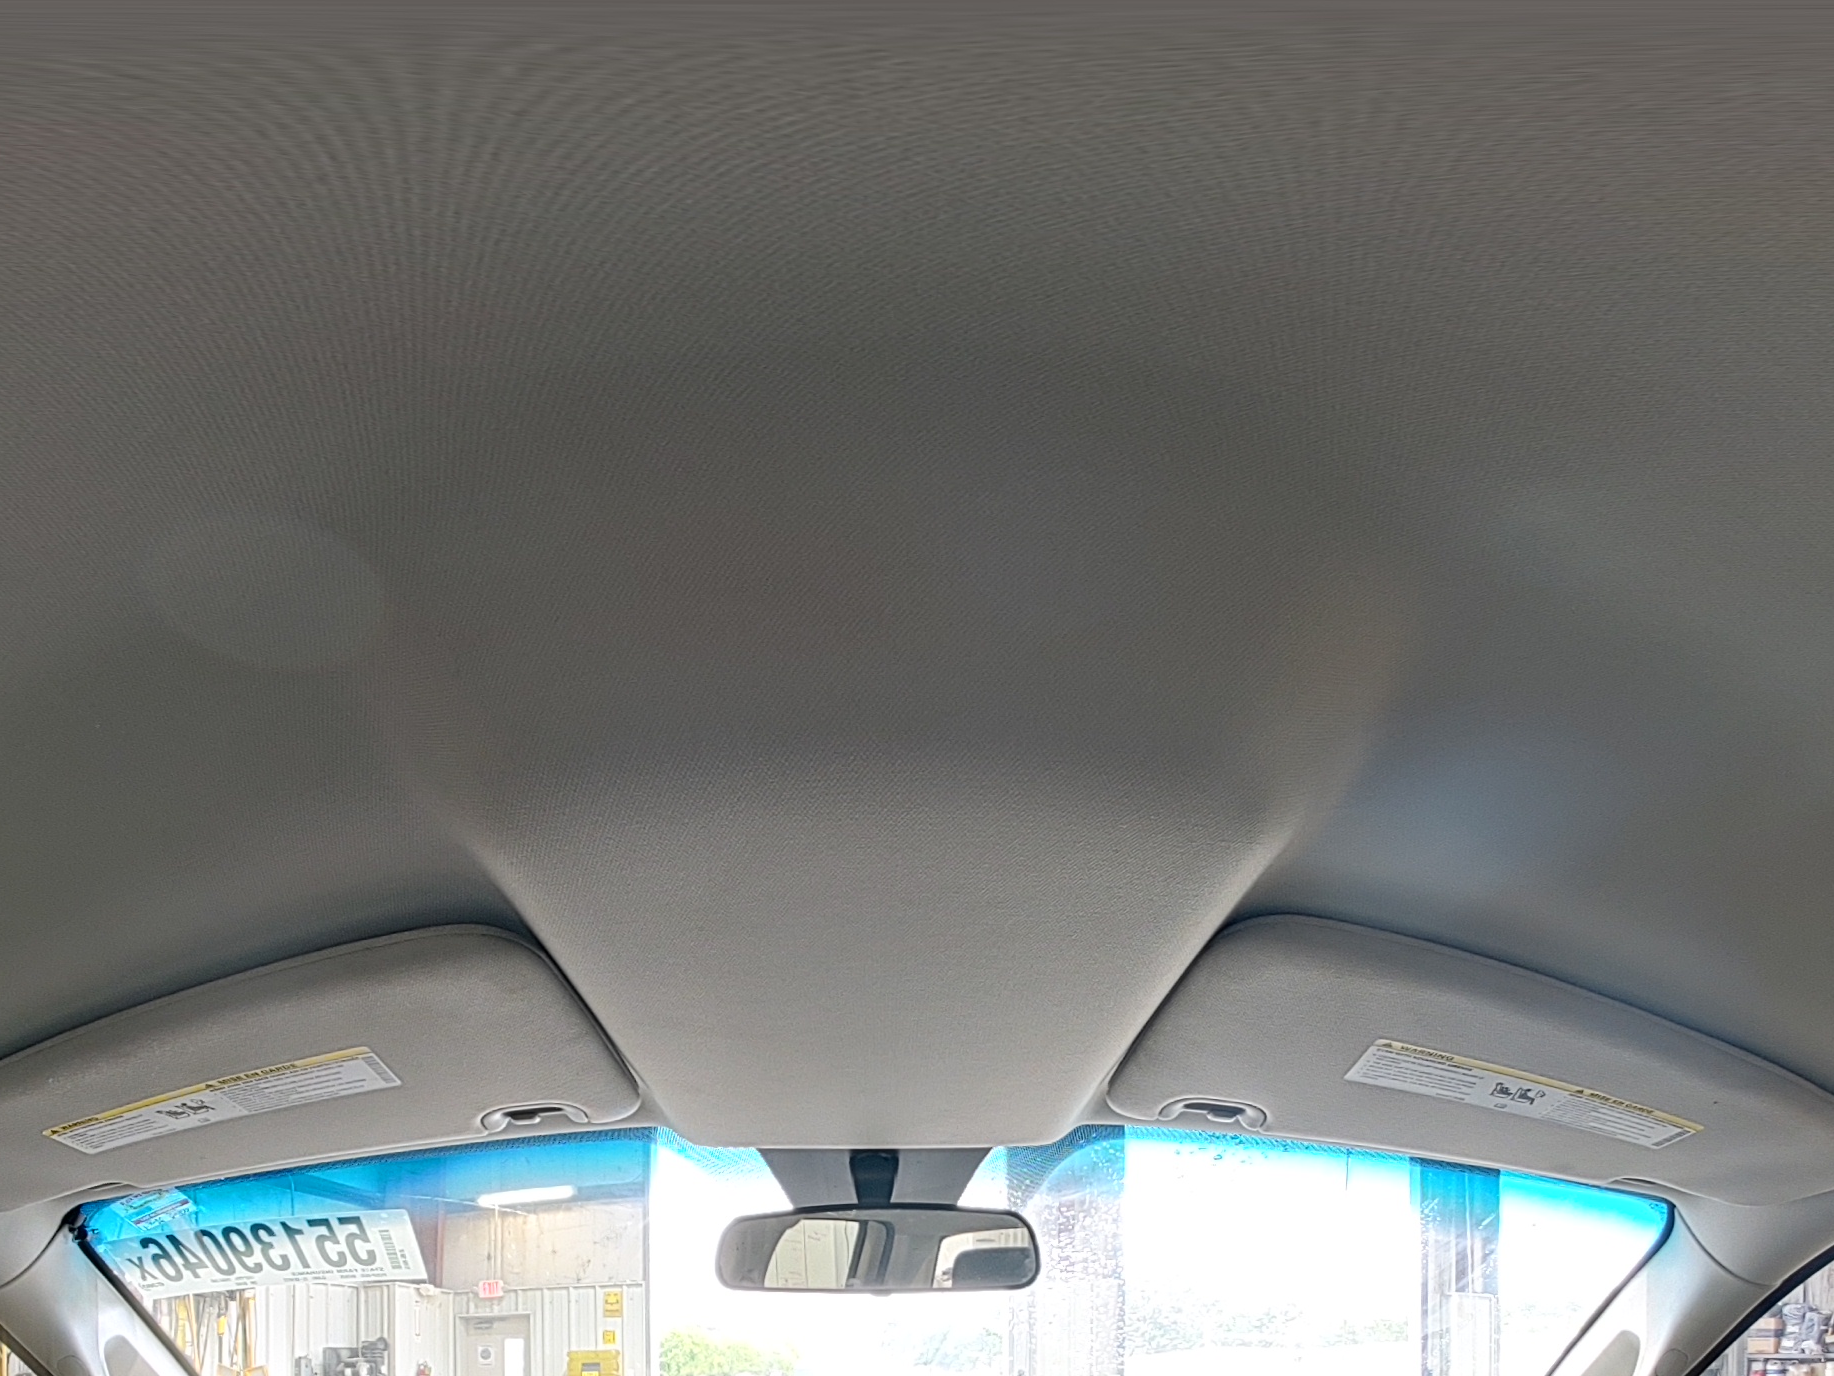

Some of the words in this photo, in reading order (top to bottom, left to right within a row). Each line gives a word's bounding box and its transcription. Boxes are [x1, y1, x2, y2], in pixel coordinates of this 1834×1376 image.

[1399, 1045, 1455, 1062] WARNING
[262, 1063, 298, 1076] GARDE
[482, 1281, 499, 1294] EXIT
